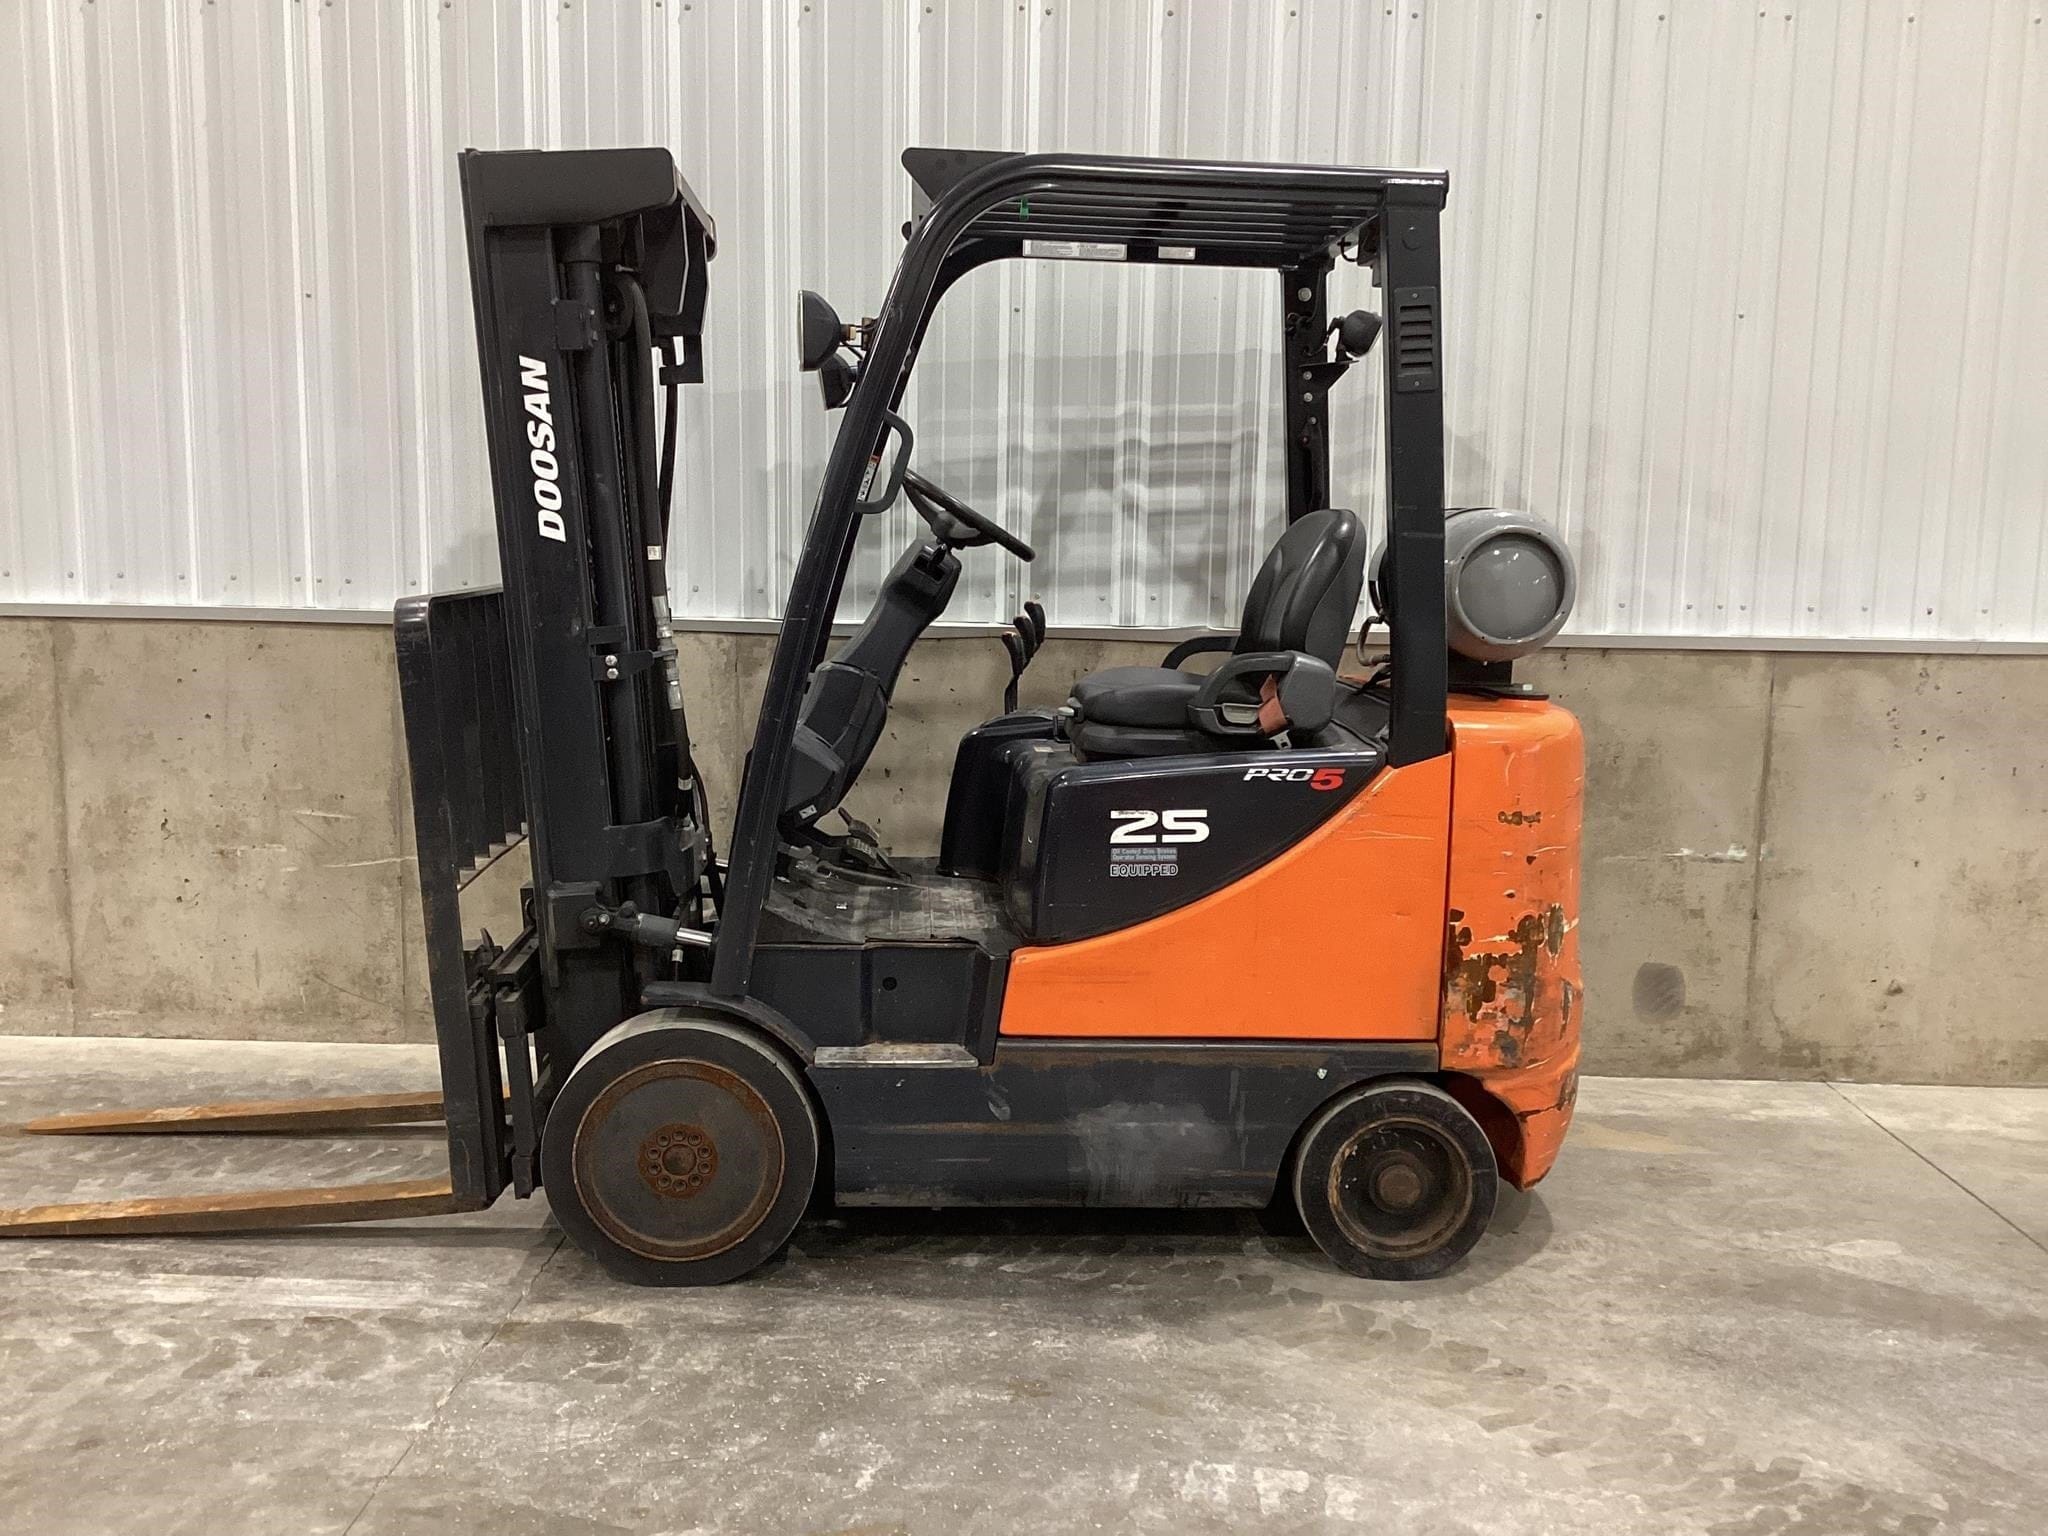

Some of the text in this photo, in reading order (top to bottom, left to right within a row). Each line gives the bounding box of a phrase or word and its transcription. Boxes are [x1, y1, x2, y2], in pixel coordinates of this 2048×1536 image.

[518, 355, 567, 543] DOOSAN
[1109, 808, 1210, 844] 25
[1110, 863, 1179, 877] EQUIPPED
